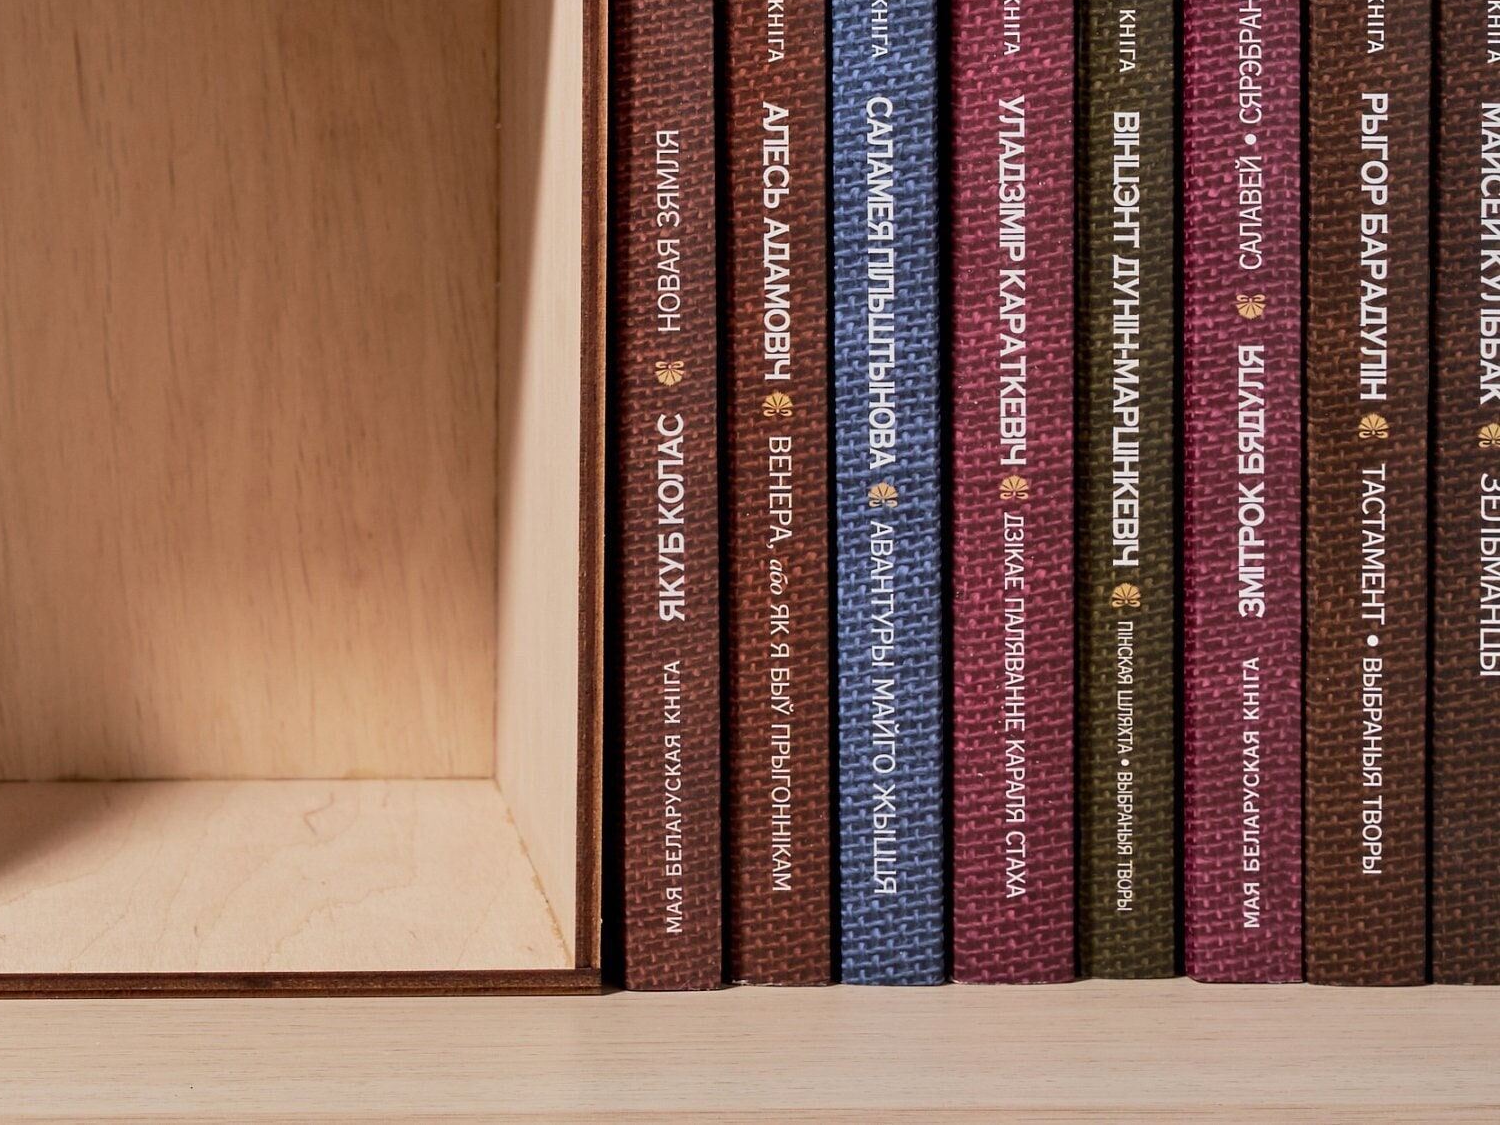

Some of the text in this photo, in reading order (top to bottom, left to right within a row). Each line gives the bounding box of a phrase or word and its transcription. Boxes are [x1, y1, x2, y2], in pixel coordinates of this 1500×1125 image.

[766, 0, 784, 63] КНІГА
[1118, 9, 1137, 73] КНІГА
[656, 129, 681, 332] НОВАЯ ЗЯМЛЯ
[762, 101, 791, 380] АЛЕСЬ АДАМОВІЧ
[866, 96, 897, 470] САЛАМЕЯ ПІЛЬШТЫНОВА
[998, 94, 1027, 466] УЛАДЗІМІР КАРАТКЕВІЧ
[1112, 111, 1141, 567] ВІНЦЭНТ ДУНІН-МАРЦІНКЕВІЧ
[1234, 155, 1263, 270] САЛАВЕЙ
[1359, 92, 1389, 400] РЫГОР БАРАДУЛІН
[656, 413, 686, 622] ЯКУБ КОЛАС
[1237, 344, 1266, 618] ЗМІТРОК БЯДУЛЯ
[664, 660, 682, 934] МАЯ БЕЛАРУСКАЯ КНІГА
[766, 436, 794, 891] ВЕНЕРА, або ЯК Я БЫЎ ПРЫГОННІКАМ
[870, 520, 900, 894] АВАНТУРЫ МАЙГО ЖЫЦЦЯ
[1003, 511, 1027, 899] ДЗІКАЕ ПАЛЯВАННЕ КАРАЛЯ СТАХА
[1116, 621, 1134, 911] ПІНСКАЯ ШЛЯХТА ВЫБРАНЫЯ ТВОРЫ
[1242, 657, 1260, 928] МАЯ БЕЛАРУСКАЯ КНІГА
[1361, 463, 1386, 874] ТАСТАМЕНТ ВЫБРАНЫЯ ТВОРЫ
